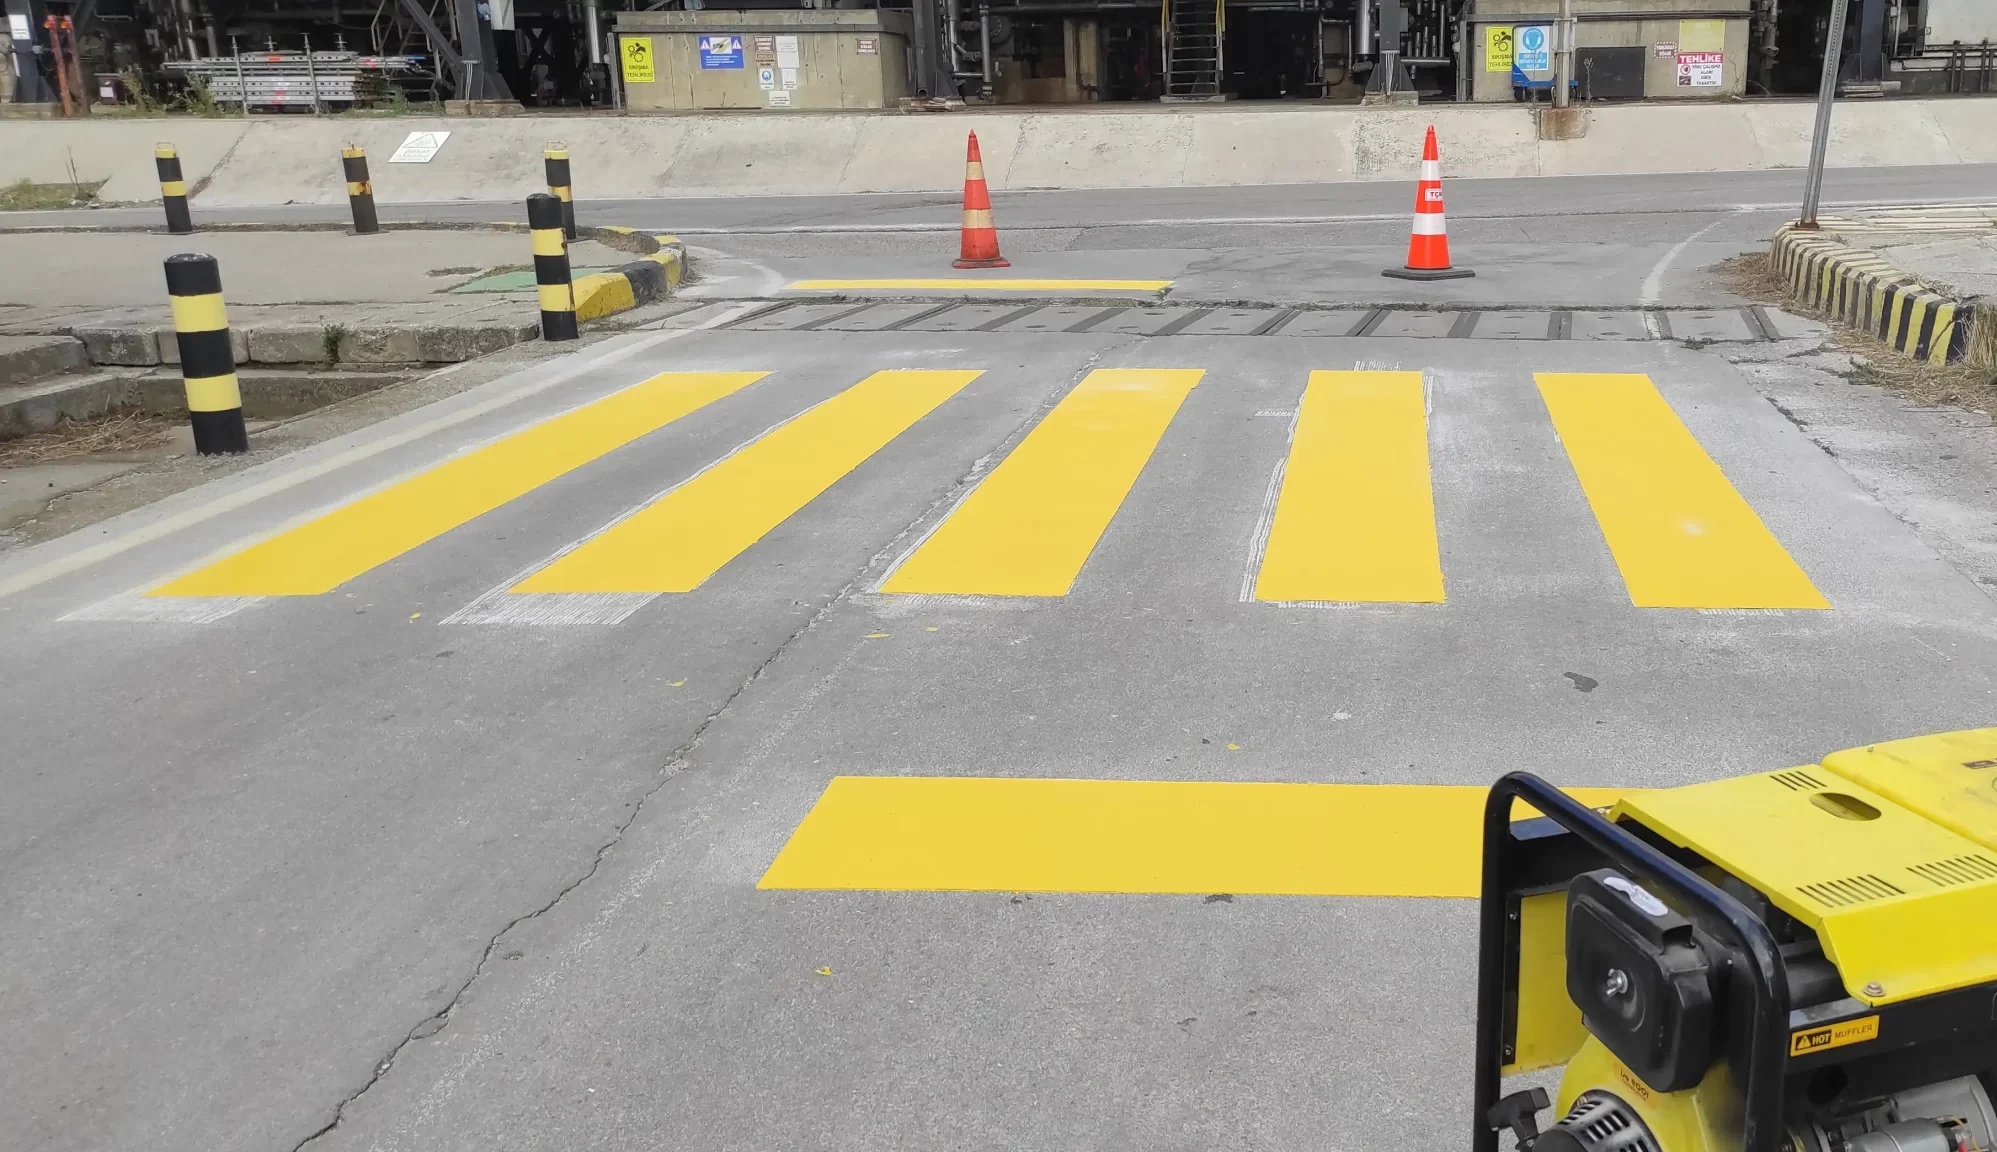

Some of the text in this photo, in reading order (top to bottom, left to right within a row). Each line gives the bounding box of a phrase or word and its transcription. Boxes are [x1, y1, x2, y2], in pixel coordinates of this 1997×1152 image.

[1680, 54, 1722, 62] TEHLİKE
[1812, 1024, 1872, 1046] HOT MUFFLER
